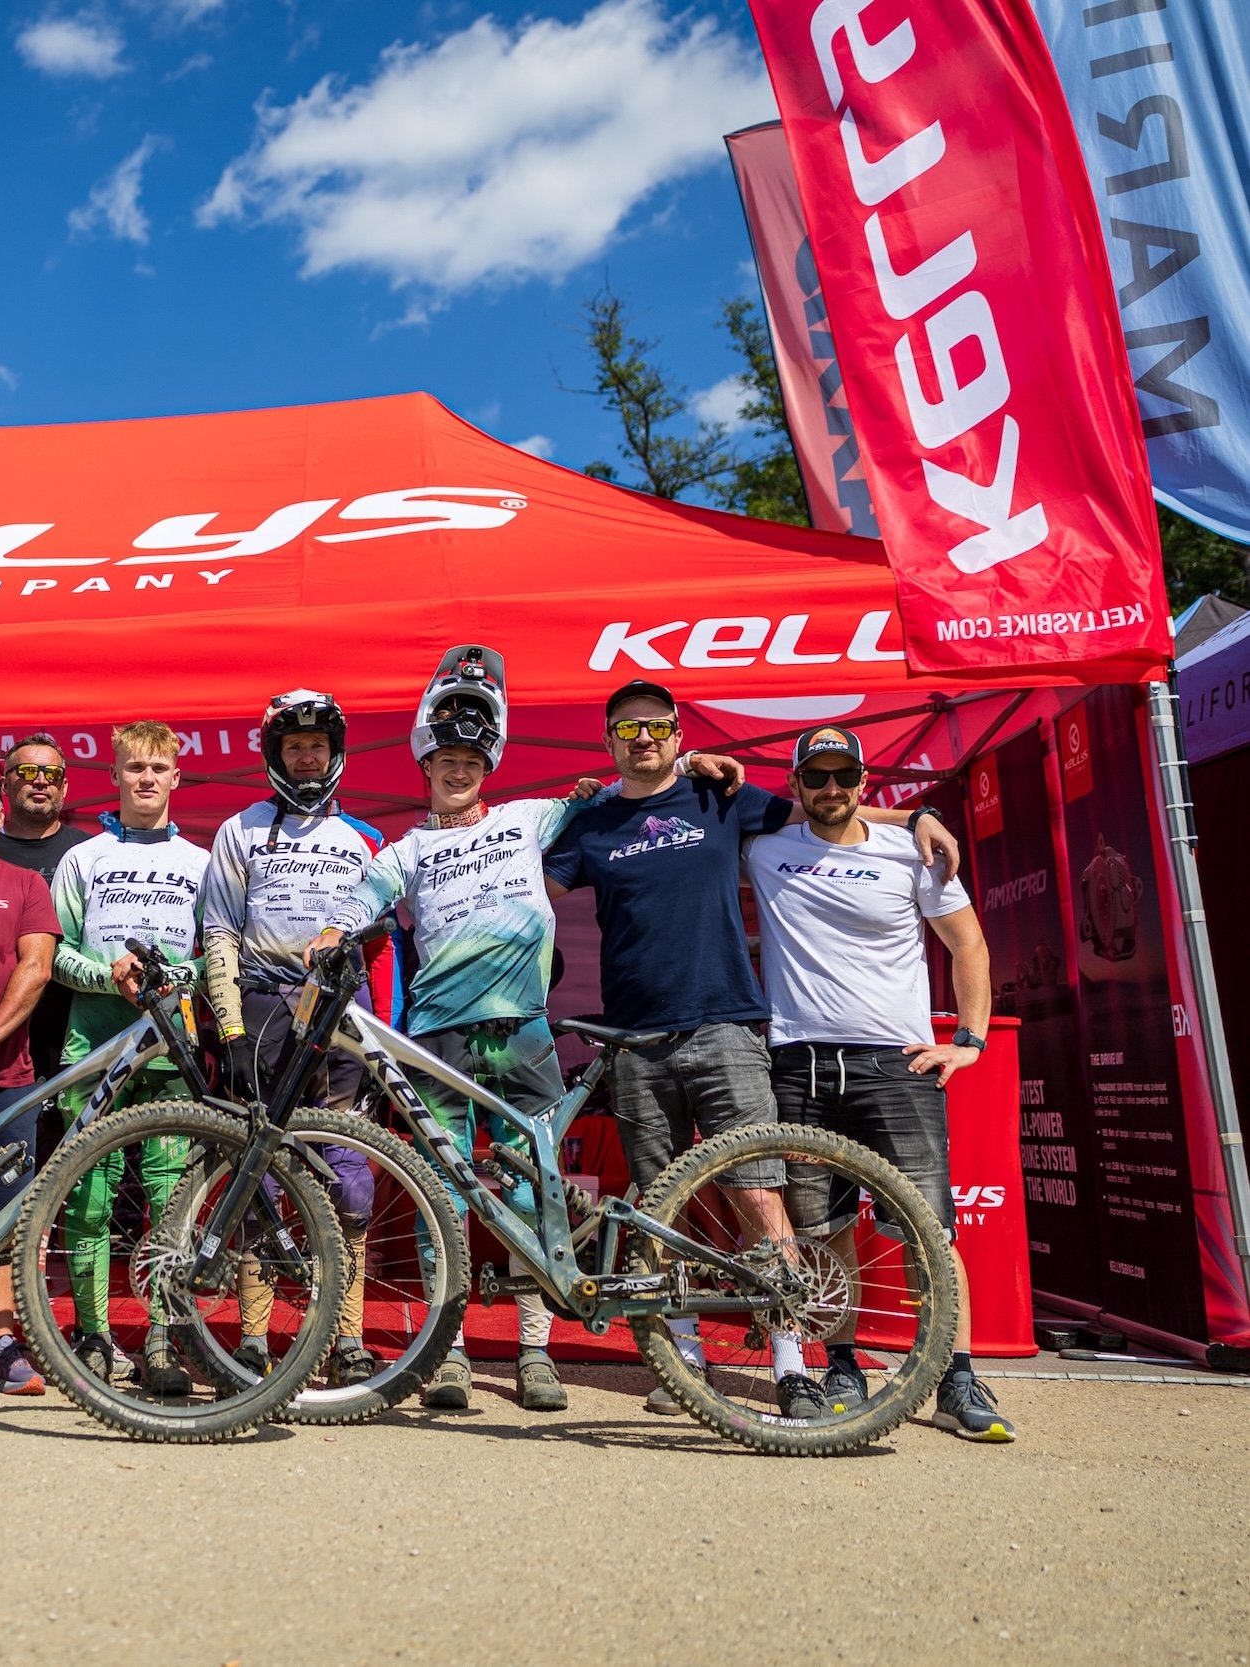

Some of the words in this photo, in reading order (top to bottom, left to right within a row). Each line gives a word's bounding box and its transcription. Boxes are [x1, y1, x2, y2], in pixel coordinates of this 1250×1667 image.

[417, 827, 522, 868] KELLYS
[609, 828, 705, 861] KELLYS
[92, 871, 198, 894] KELLYS
[777, 862, 881, 880] KELLYS
[151, 890, 190, 905] Team
[1041, 1145, 1077, 1172] SYSTEM
[1026, 1177, 1044, 1201] THE
[1045, 1179, 1076, 1206] WORLD
[780, 1418, 808, 1427] SWISS
